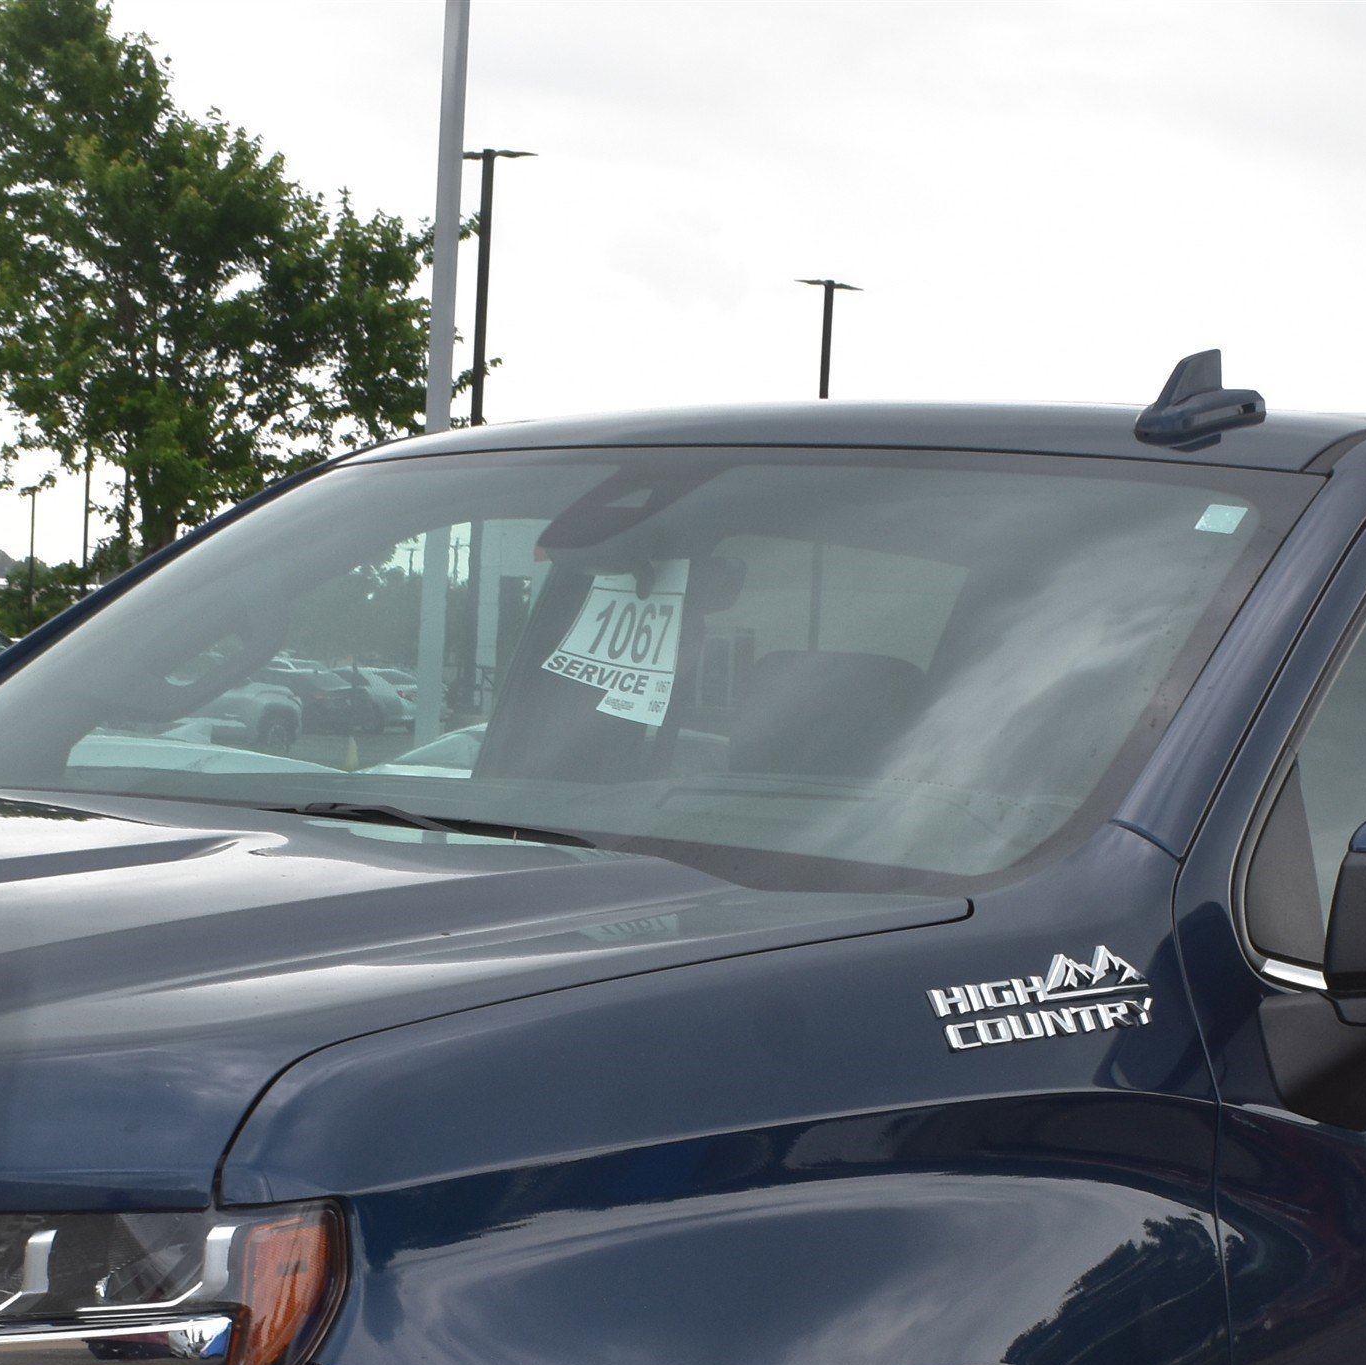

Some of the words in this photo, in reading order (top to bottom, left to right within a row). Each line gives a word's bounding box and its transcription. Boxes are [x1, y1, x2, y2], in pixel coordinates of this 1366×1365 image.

[587, 599, 674, 666] 1067
[547, 655, 649, 695] SERVICE
[926, 976, 1048, 1018] HIGH
[943, 997, 1154, 1052] COUNTRY
